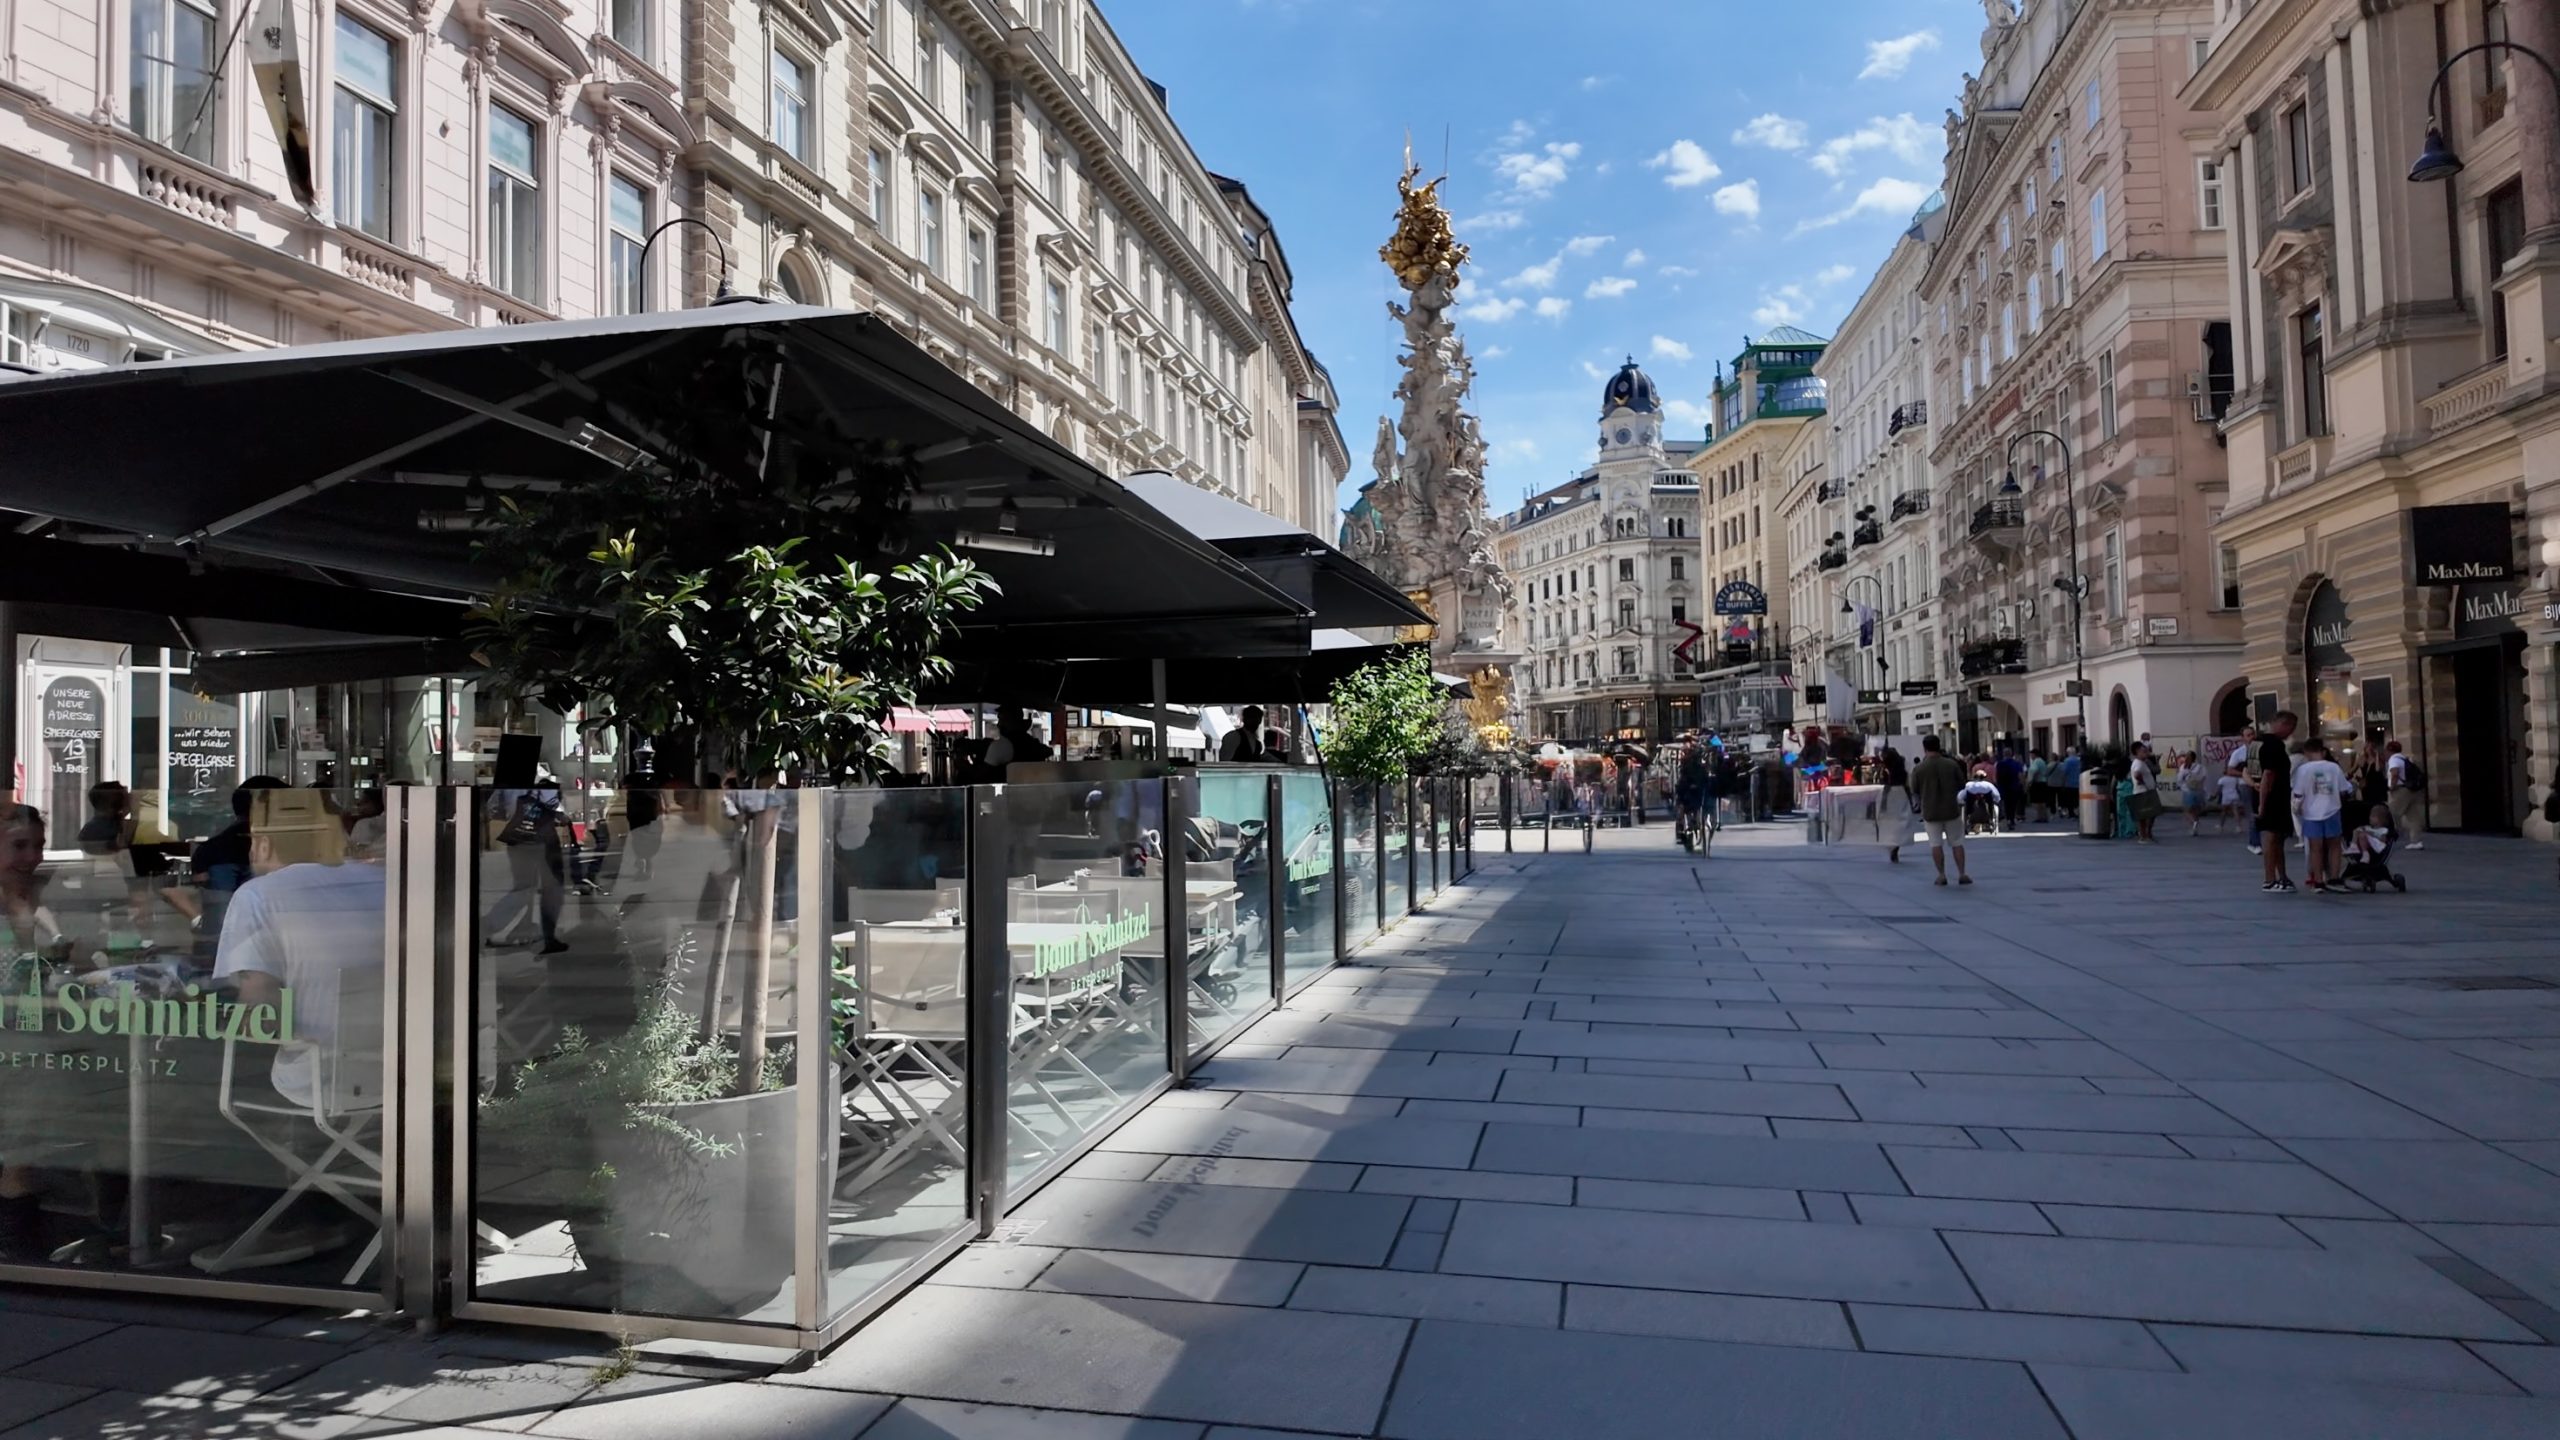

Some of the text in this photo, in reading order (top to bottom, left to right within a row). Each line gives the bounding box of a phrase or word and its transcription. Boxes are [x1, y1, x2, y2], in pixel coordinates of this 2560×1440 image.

[67, 334, 90, 353] 1720
[2428, 562, 2503, 579] MaxMara
[2465, 591, 2525, 622] MaxMar
[2544, 603, 2560, 621] BIJ
[52, 688, 93, 699] UNSERE
[57, 700, 85, 709] NEUE
[63, 739, 86, 756] 13
[181, 739, 230, 748] uns wieder
[168, 752, 236, 769] SPIEGELGASSE
[194, 768, 211, 788] 13
[1034, 902, 1150, 979] Dom Schnitzel
[57, 983, 293, 1041] Schnitzel
